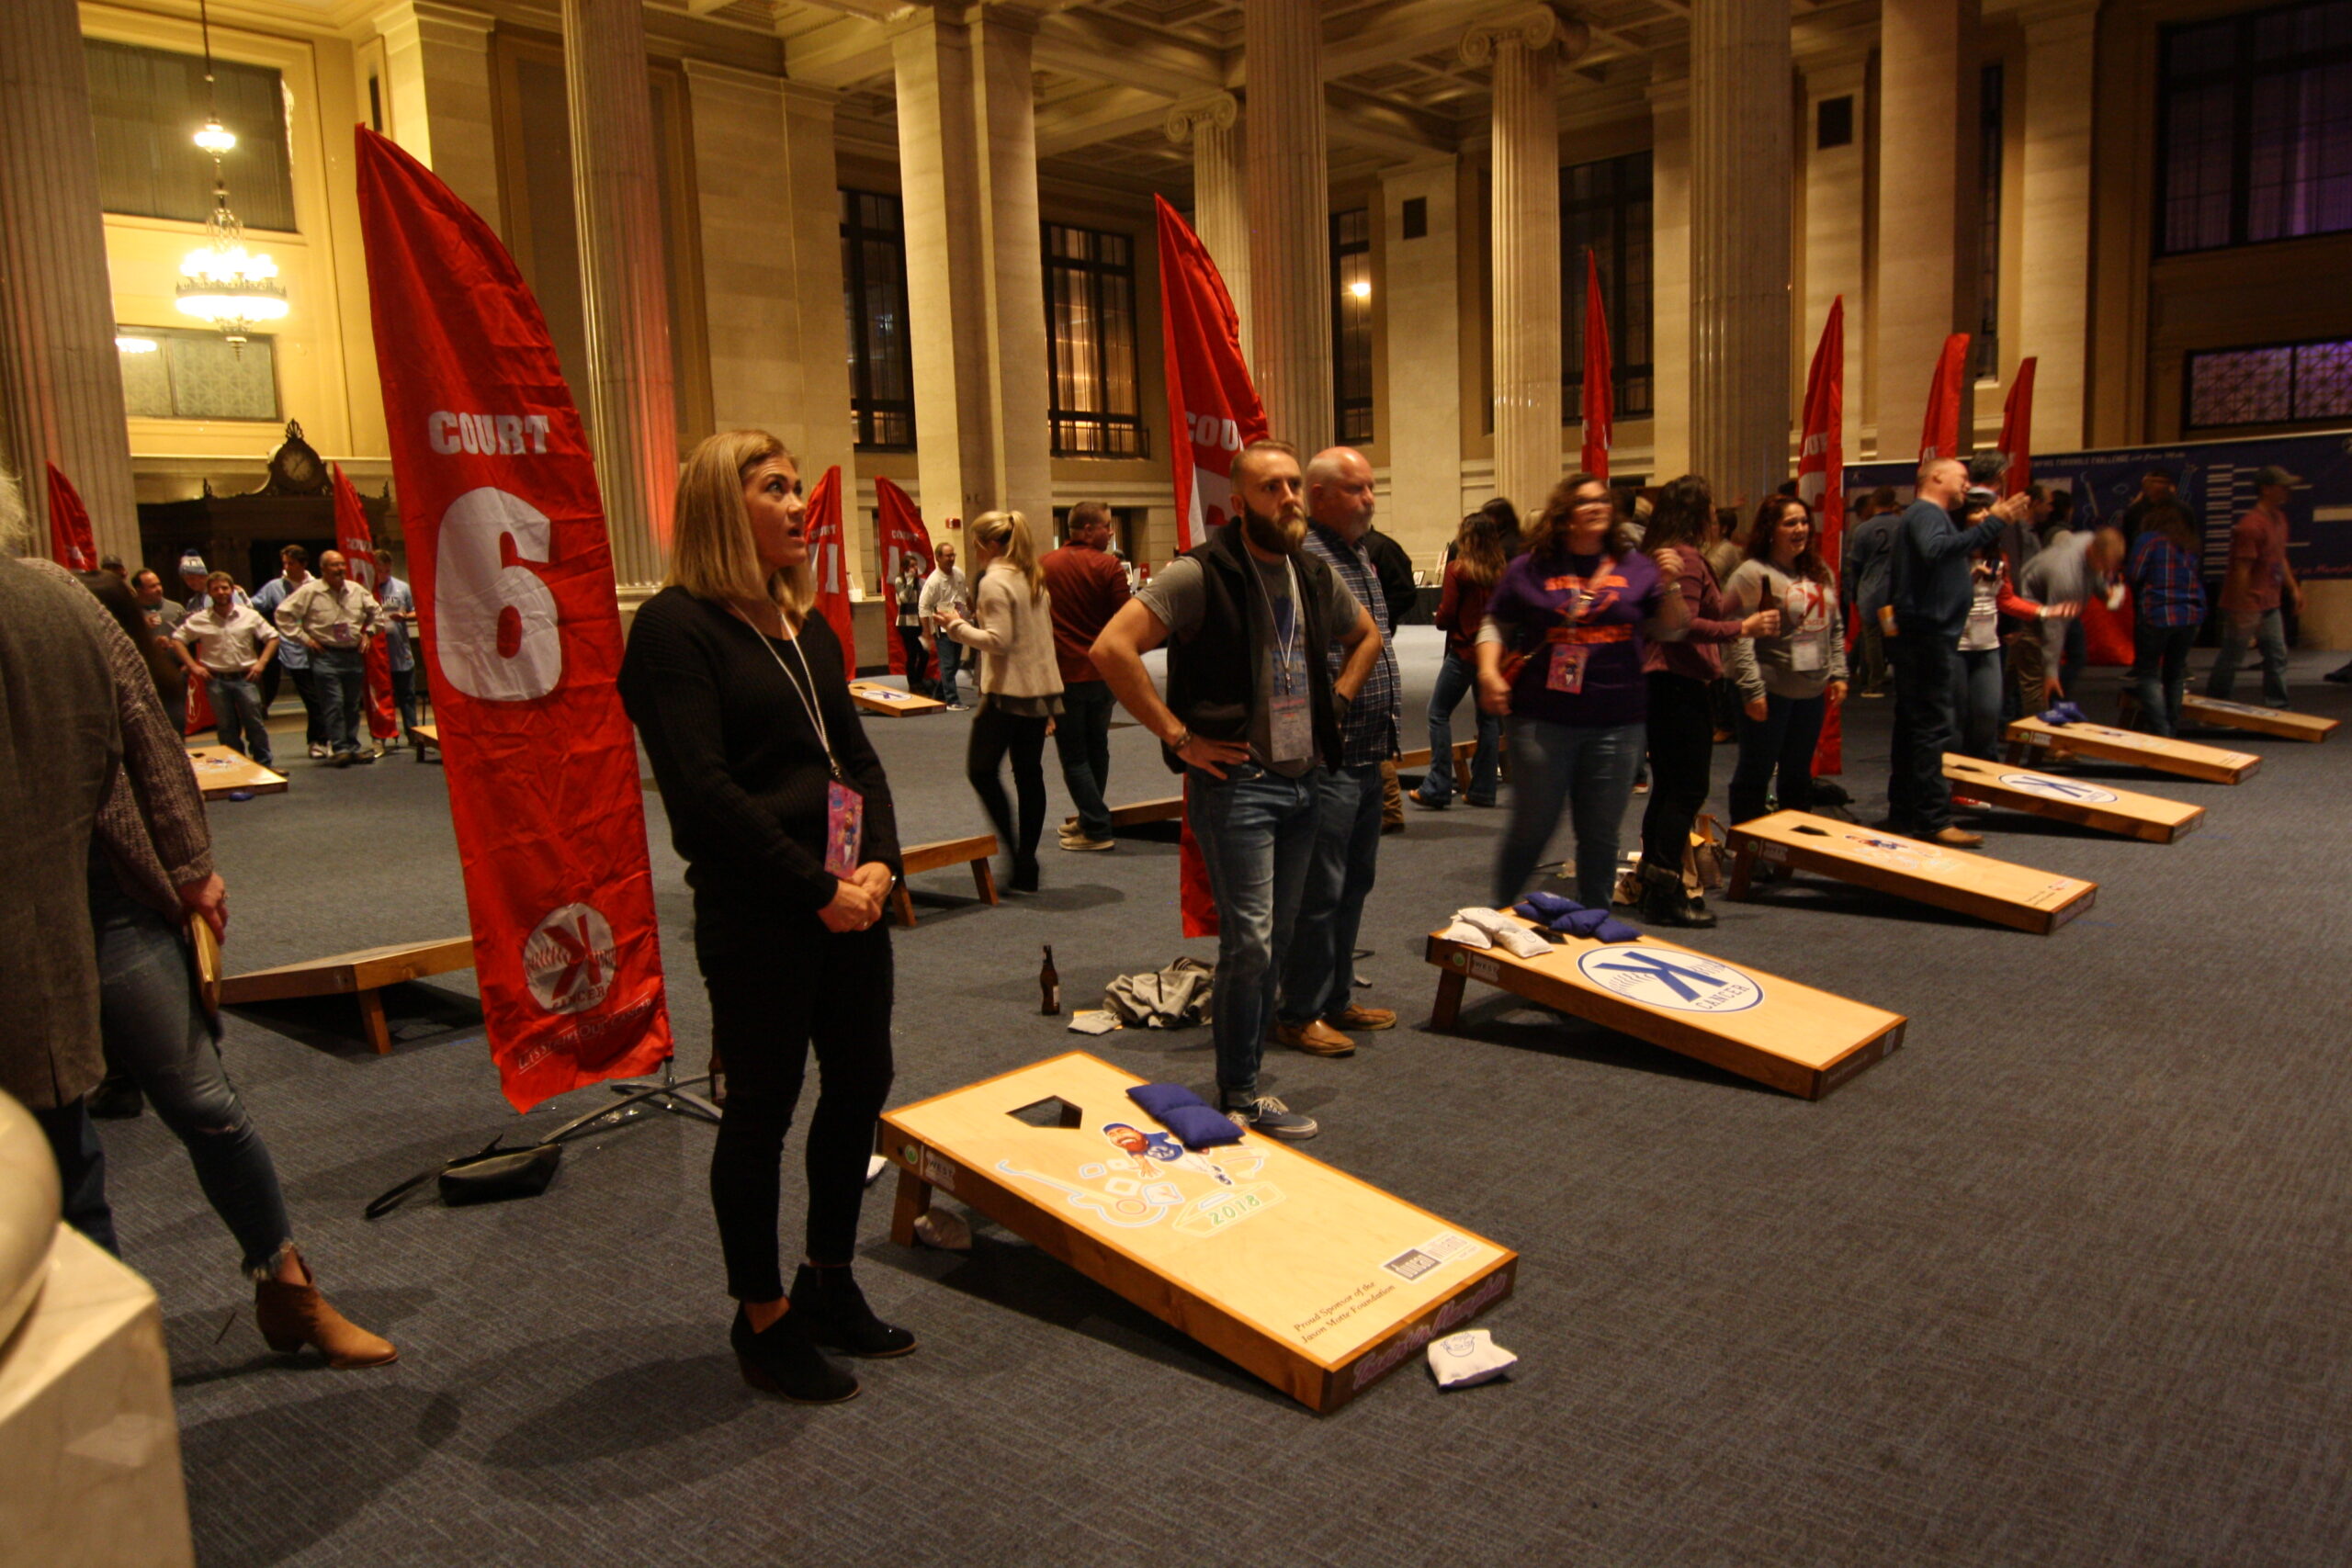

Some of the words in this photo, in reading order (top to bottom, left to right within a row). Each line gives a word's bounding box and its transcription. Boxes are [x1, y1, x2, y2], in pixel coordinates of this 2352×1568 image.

[427, 410, 549, 456] COURT
[1185, 411, 1245, 452] COU
[435, 486, 562, 702] 6
[551, 986, 605, 1011] CANCER
[1695, 984, 1751, 1010] CANCER
[1208, 1194, 1261, 1225] 2018
[1294, 1314, 1321, 1332] Proud
[1319, 1294, 1353, 1316] Sponsor
[1354, 1287, 1364, 1298] of
[1362, 1281, 1375, 1292] the
[1301, 1325, 1327, 1344] Jason
[1326, 1311, 1351, 1328] Motte
[1351, 1284, 1396, 1314] Foundation
